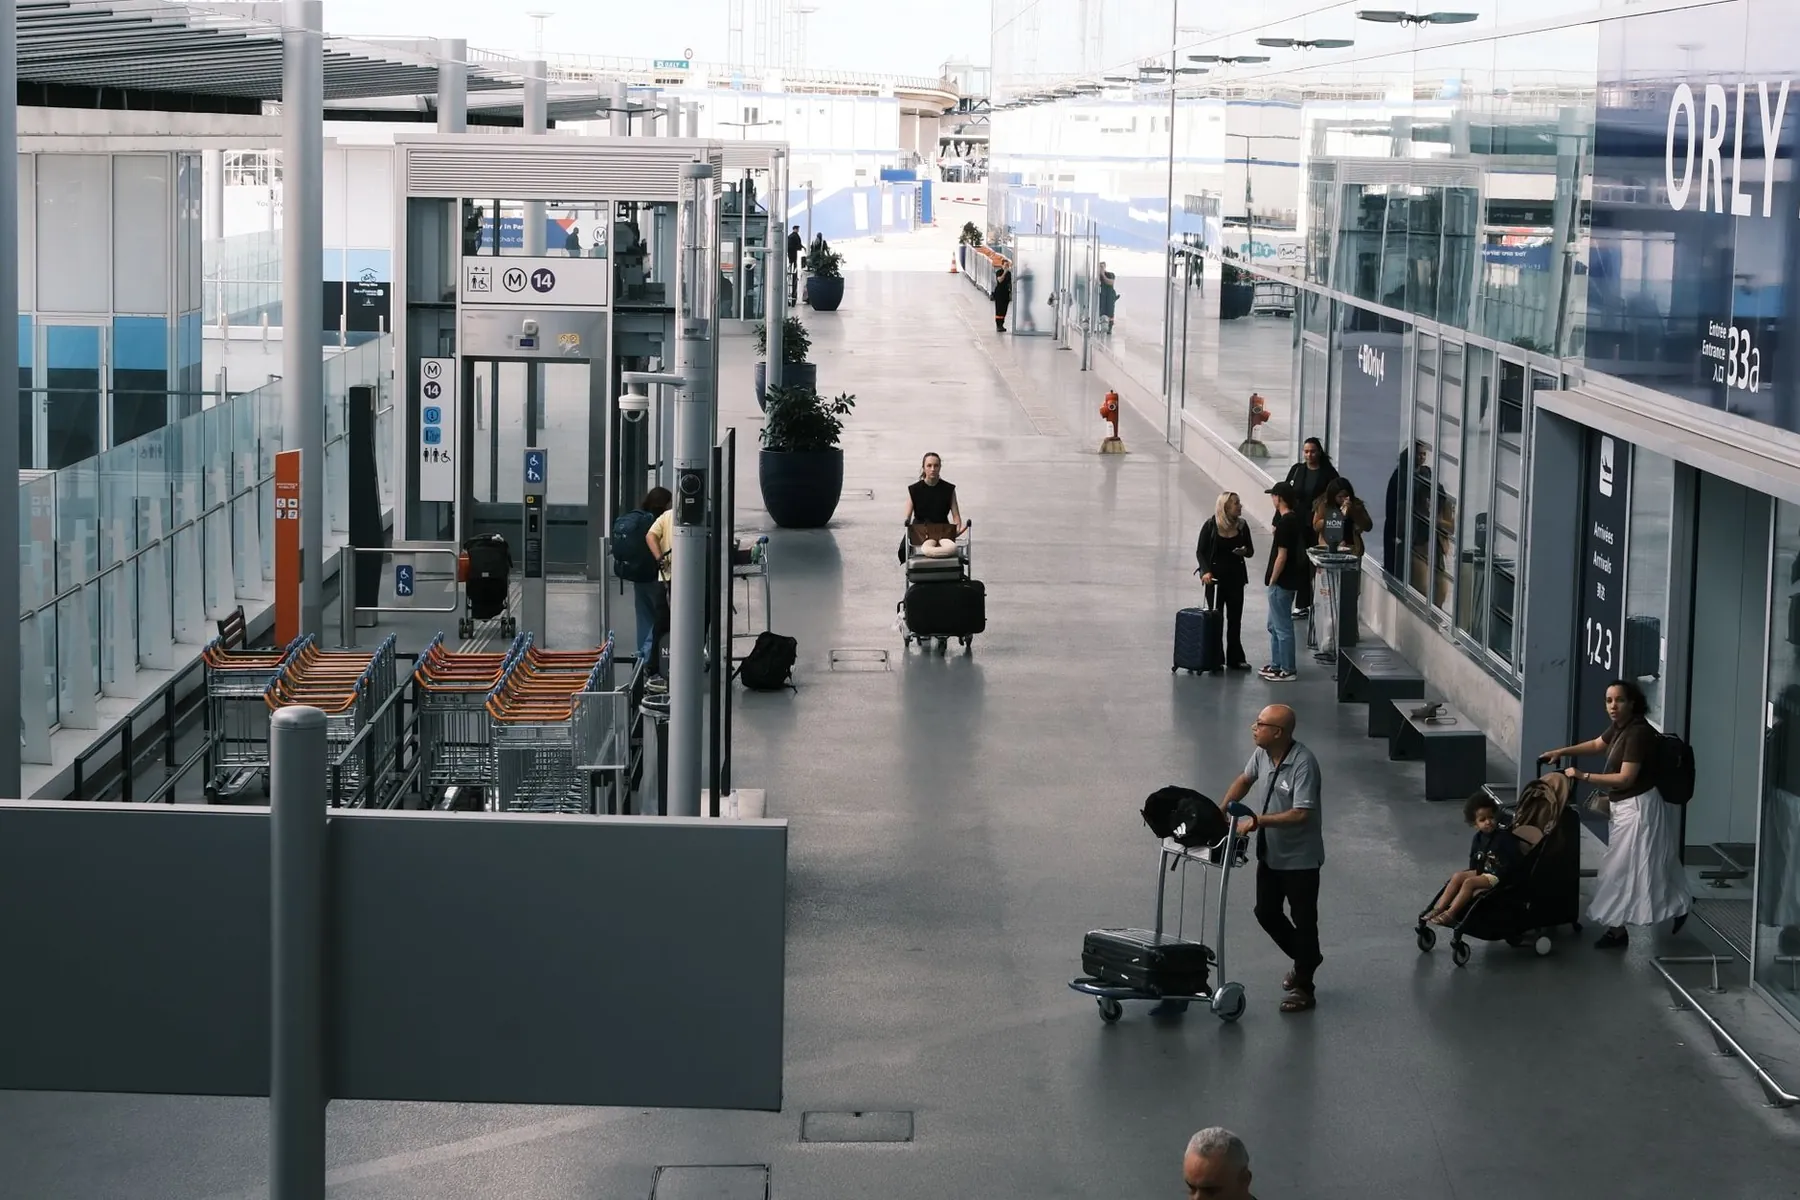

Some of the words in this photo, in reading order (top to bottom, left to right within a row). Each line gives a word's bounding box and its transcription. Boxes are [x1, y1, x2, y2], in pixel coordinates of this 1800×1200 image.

[1666, 80, 1790, 218] ORLY
[533, 273, 553, 288] 14
[1709, 320, 1727, 339] Entrée
[1702, 339, 1726, 360] Entrance
[426, 384, 440, 397] 14
[1593, 521, 1614, 545] Arrivées
[1593, 550, 1612, 575] Arrivals
